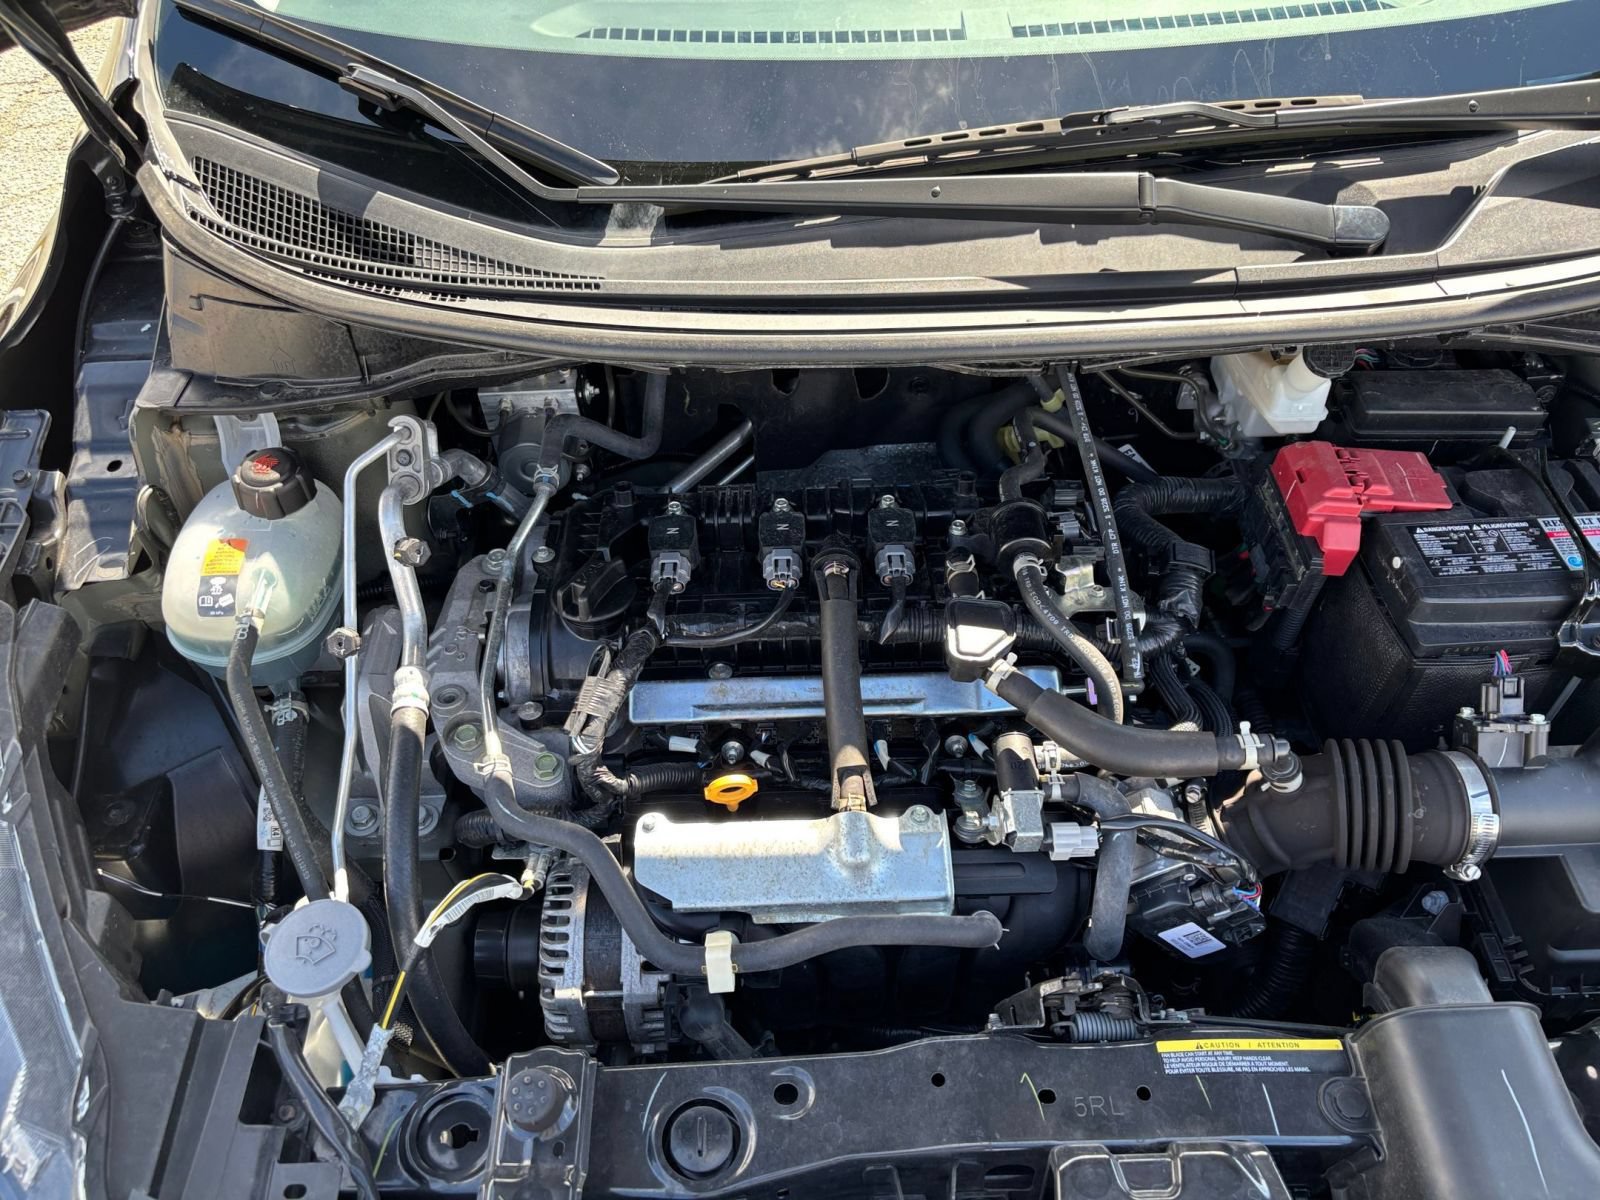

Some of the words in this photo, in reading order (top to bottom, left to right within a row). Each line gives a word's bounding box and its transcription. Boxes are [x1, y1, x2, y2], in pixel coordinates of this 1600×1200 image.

[1121, 595, 1130, 608] NOT
[272, 827, 280, 837] K4
[1074, 1095, 1125, 1117] 5RL
